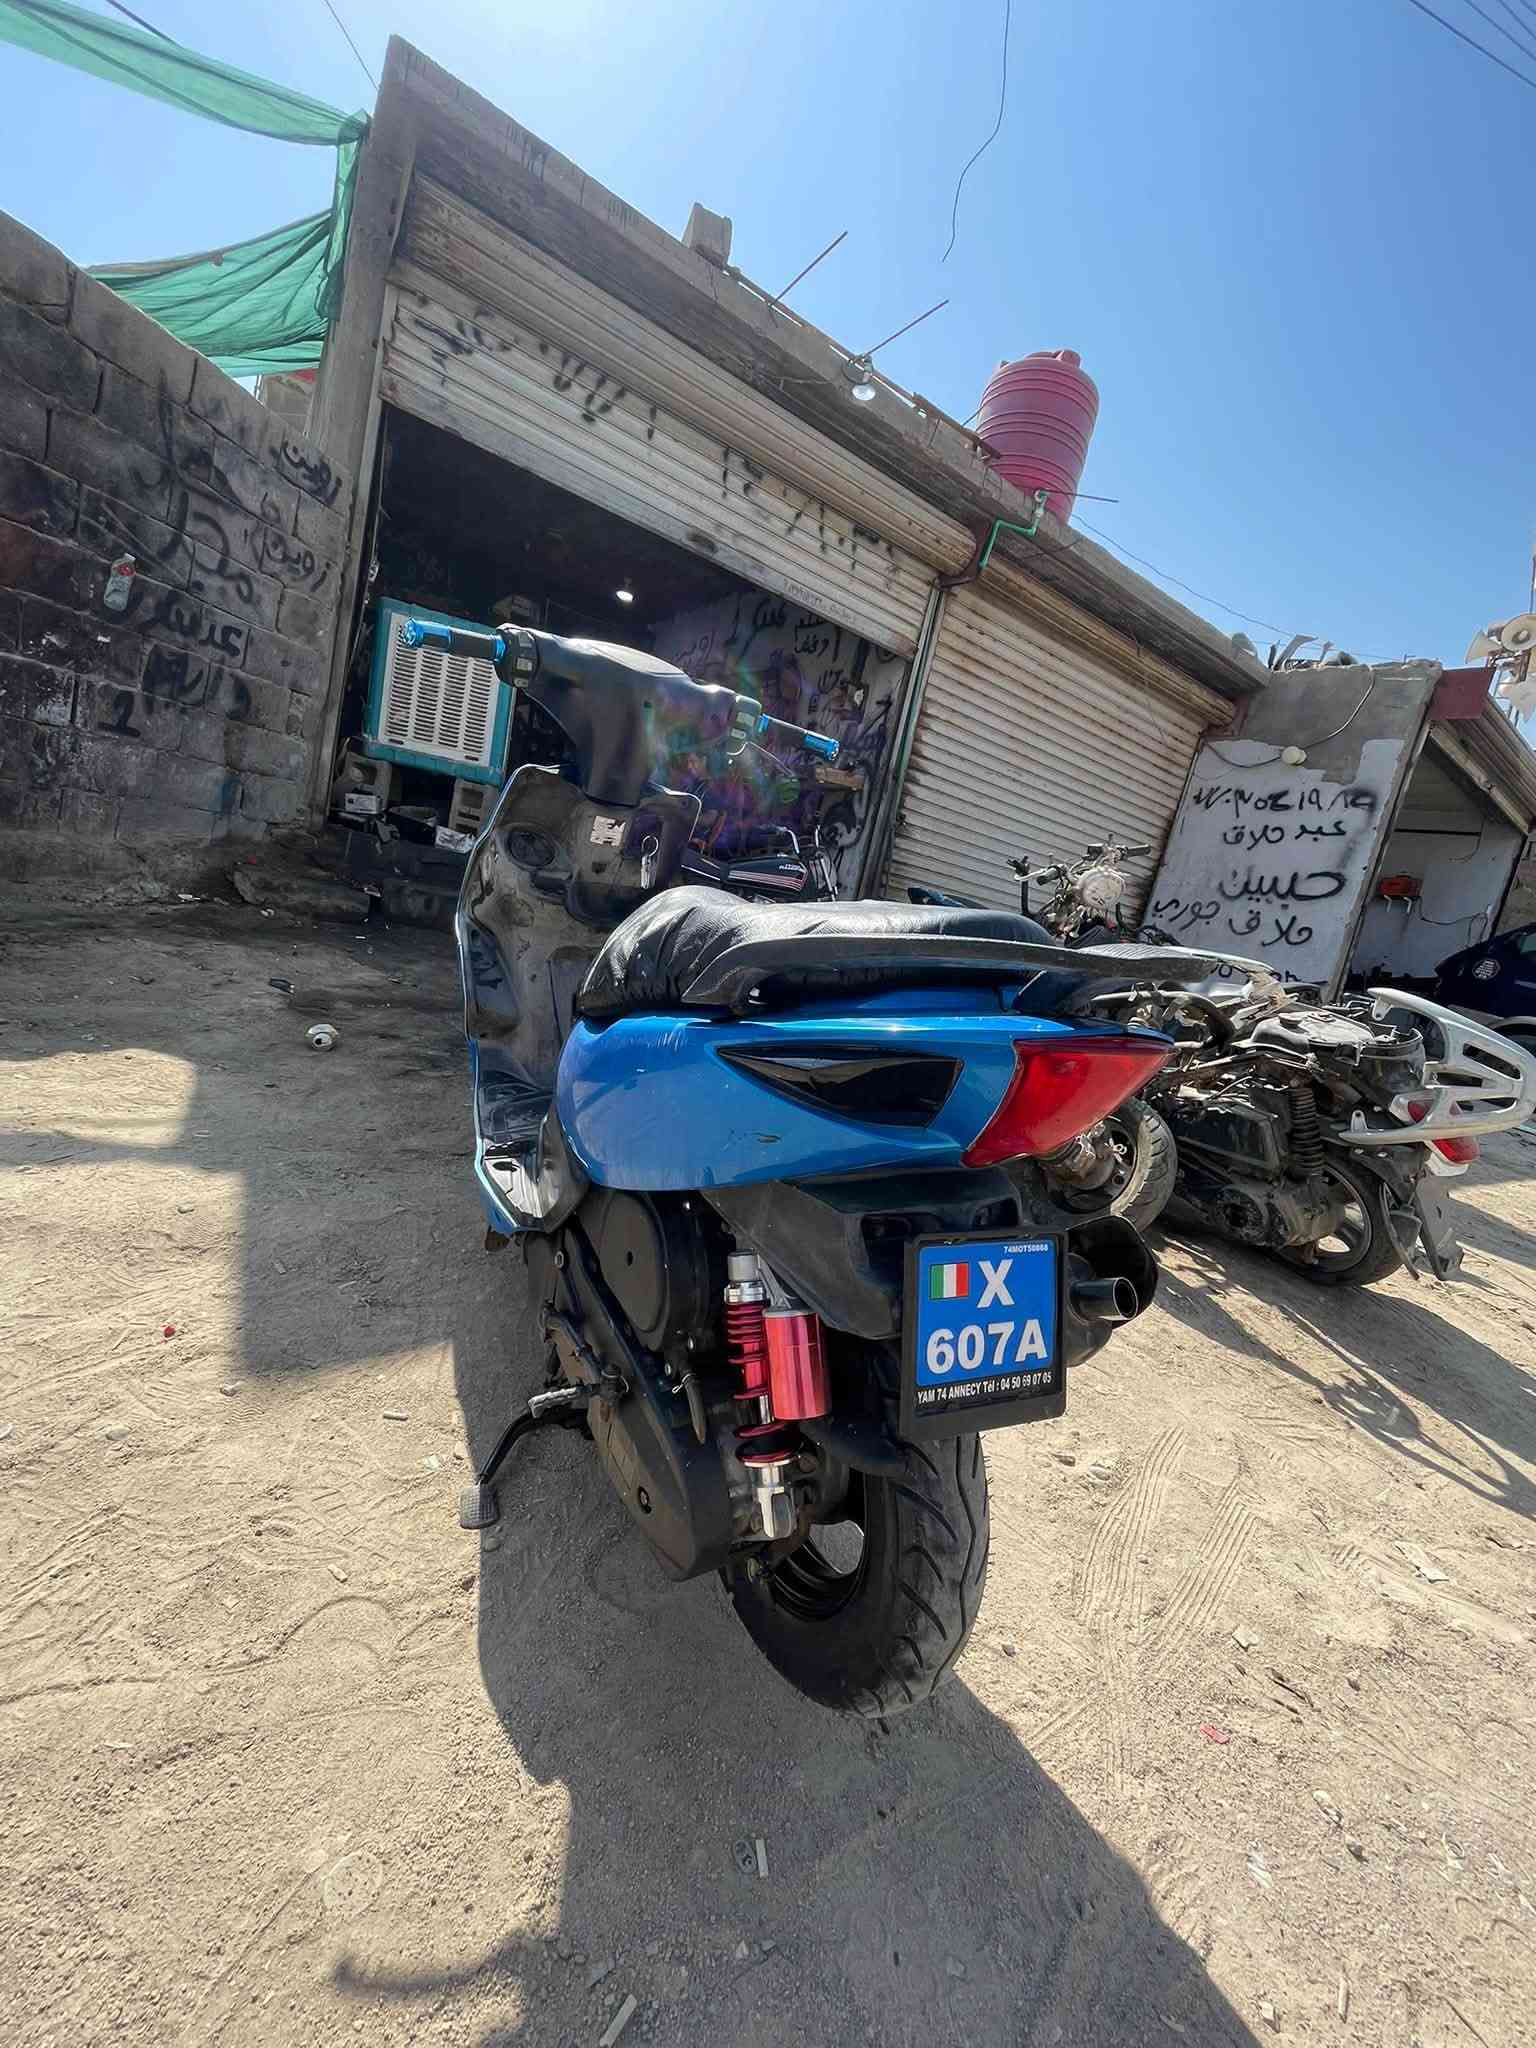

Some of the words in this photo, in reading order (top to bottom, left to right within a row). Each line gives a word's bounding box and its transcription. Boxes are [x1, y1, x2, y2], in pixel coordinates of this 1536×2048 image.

[976, 1258, 1015, 1308] X
[926, 1318, 1048, 1375] 607A
[917, 1389, 935, 1404] YAM
[936, 1388, 948, 1401] 74
[948, 1382, 982, 1400] ANNECY
[1000, 1378, 1011, 1391] 04
[1011, 1376, 1021, 1389] 50
[1032, 1373, 1042, 1385] 07
